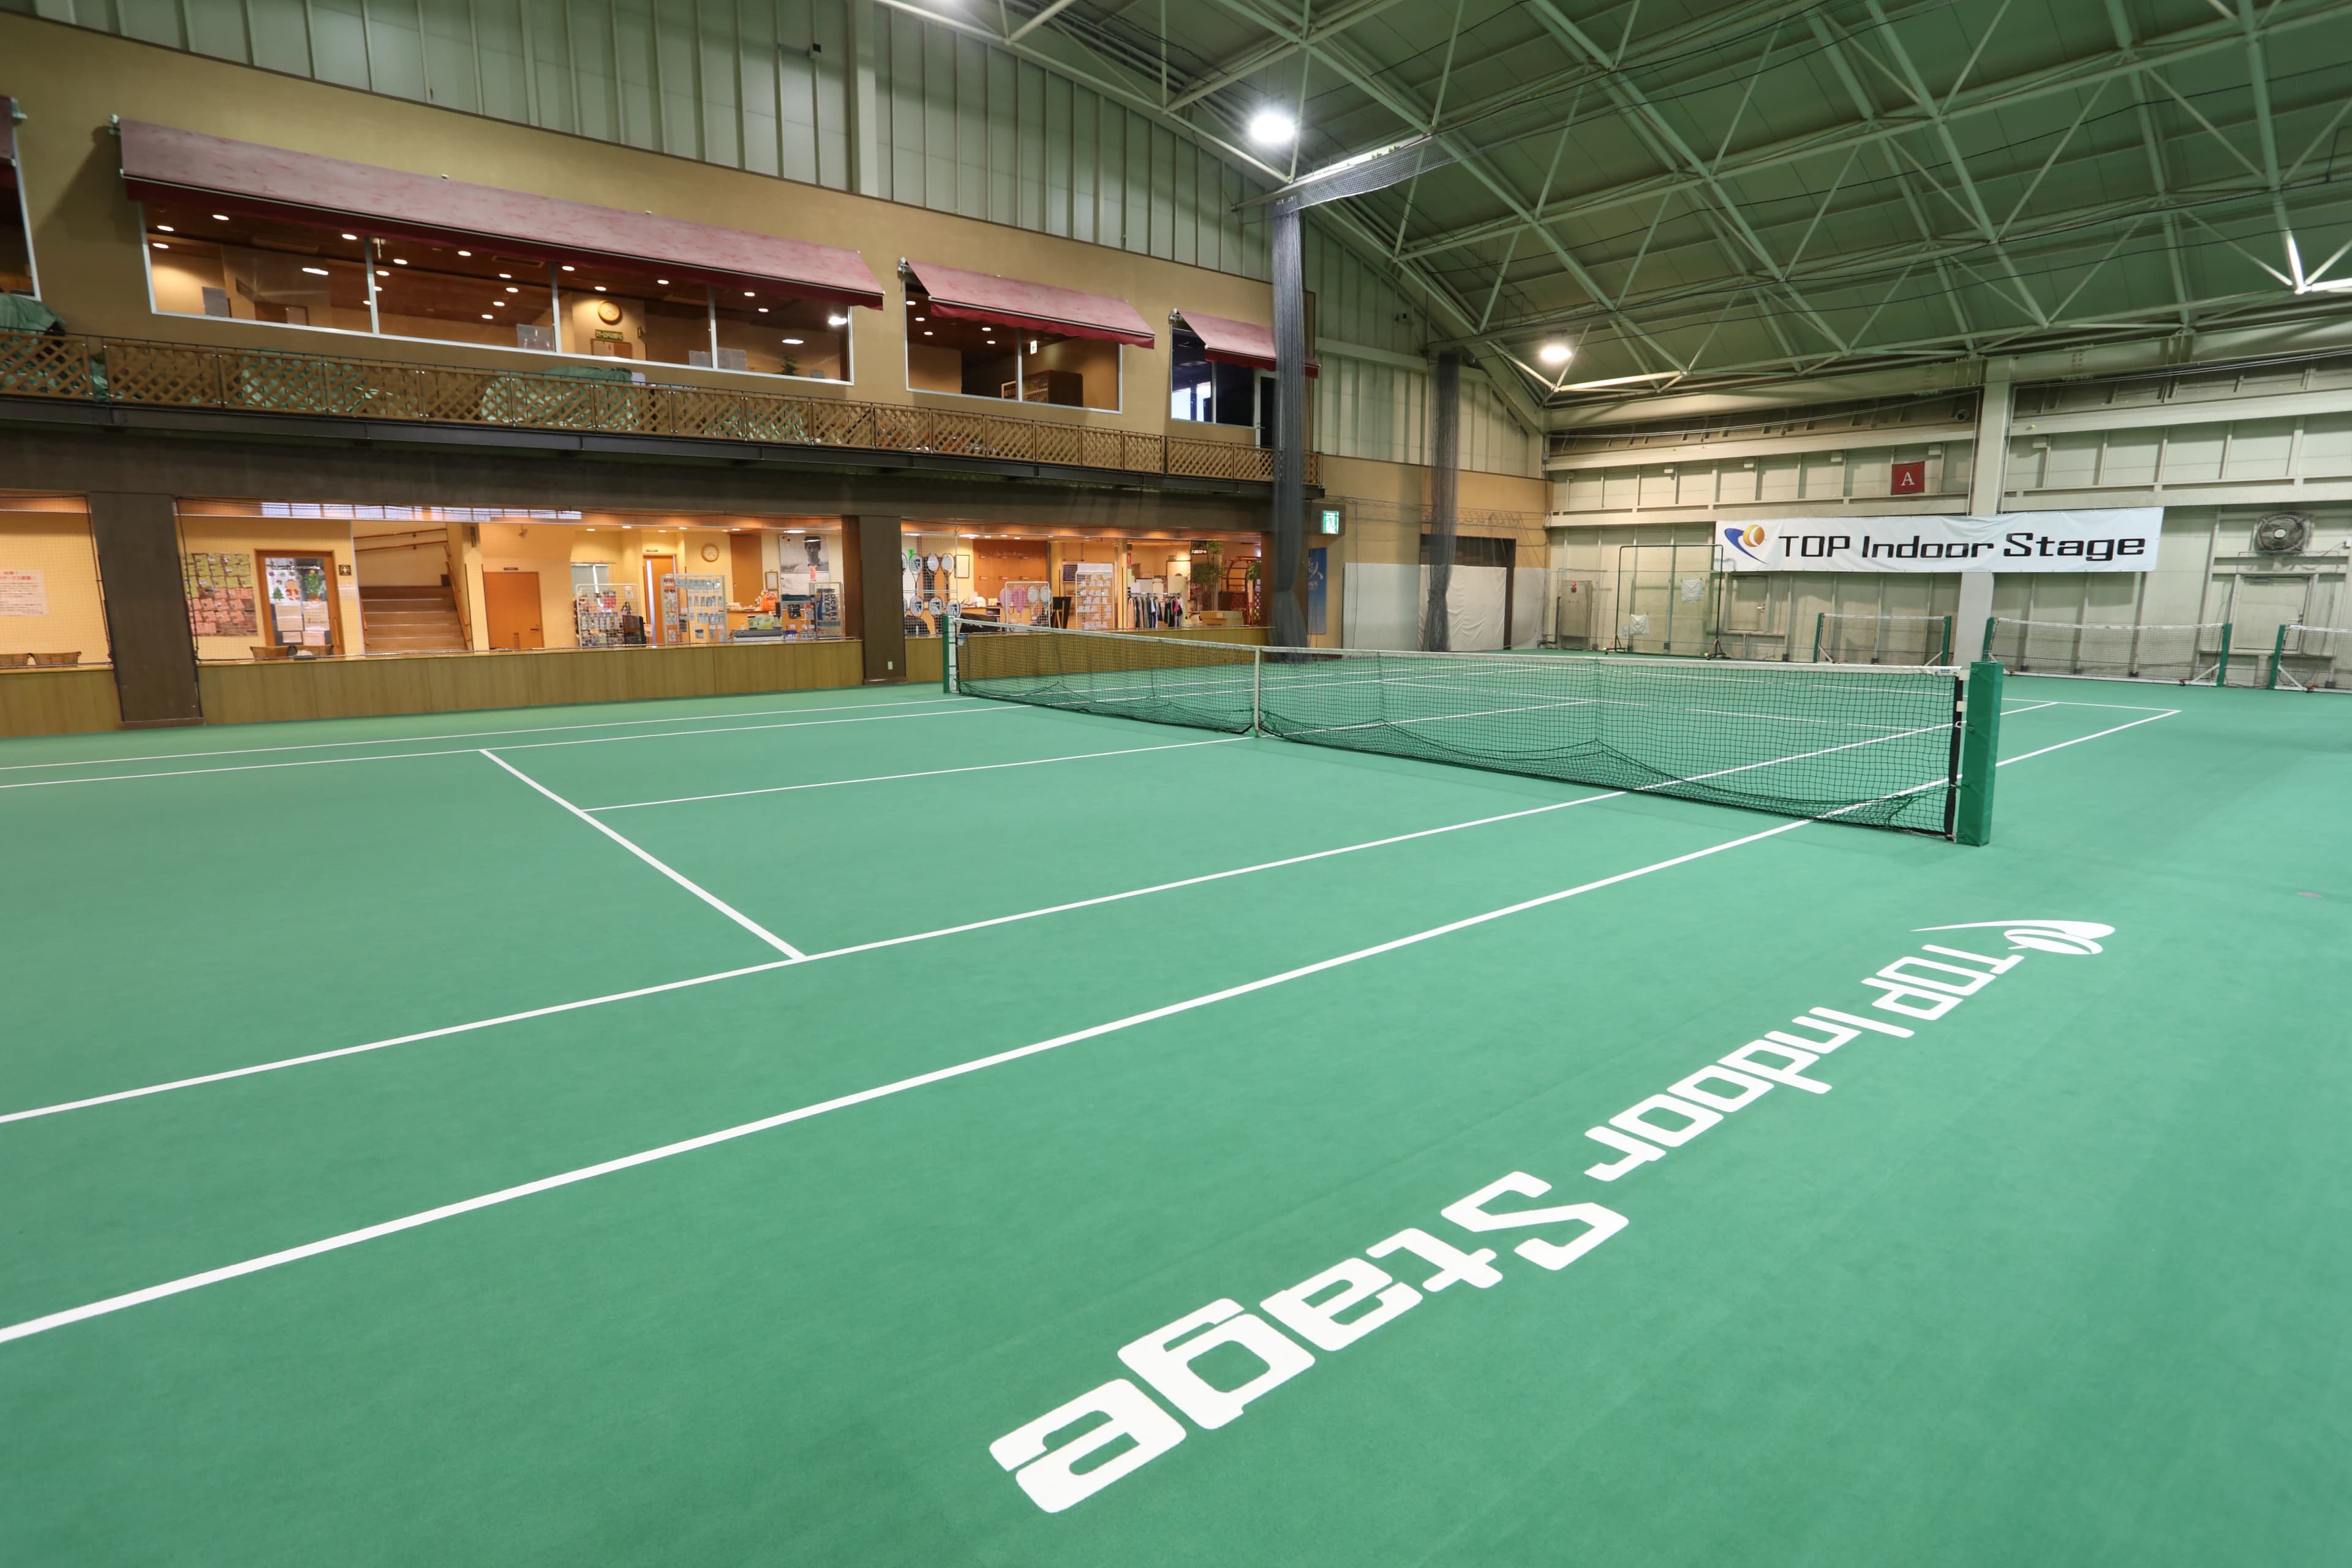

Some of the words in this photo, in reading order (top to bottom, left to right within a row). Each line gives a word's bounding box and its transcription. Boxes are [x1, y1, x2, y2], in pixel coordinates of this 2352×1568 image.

[1901, 472, 1915, 486] A
[1779, 535, 1850, 558] TOP
[1861, 535, 1994, 559] Indoor
[2003, 532, 2146, 562] Stage
[1861, 944, 2024, 1020] TOP
[1583, 1006, 1915, 1182] Indoor
[989, 1171, 1629, 1513] Stage
